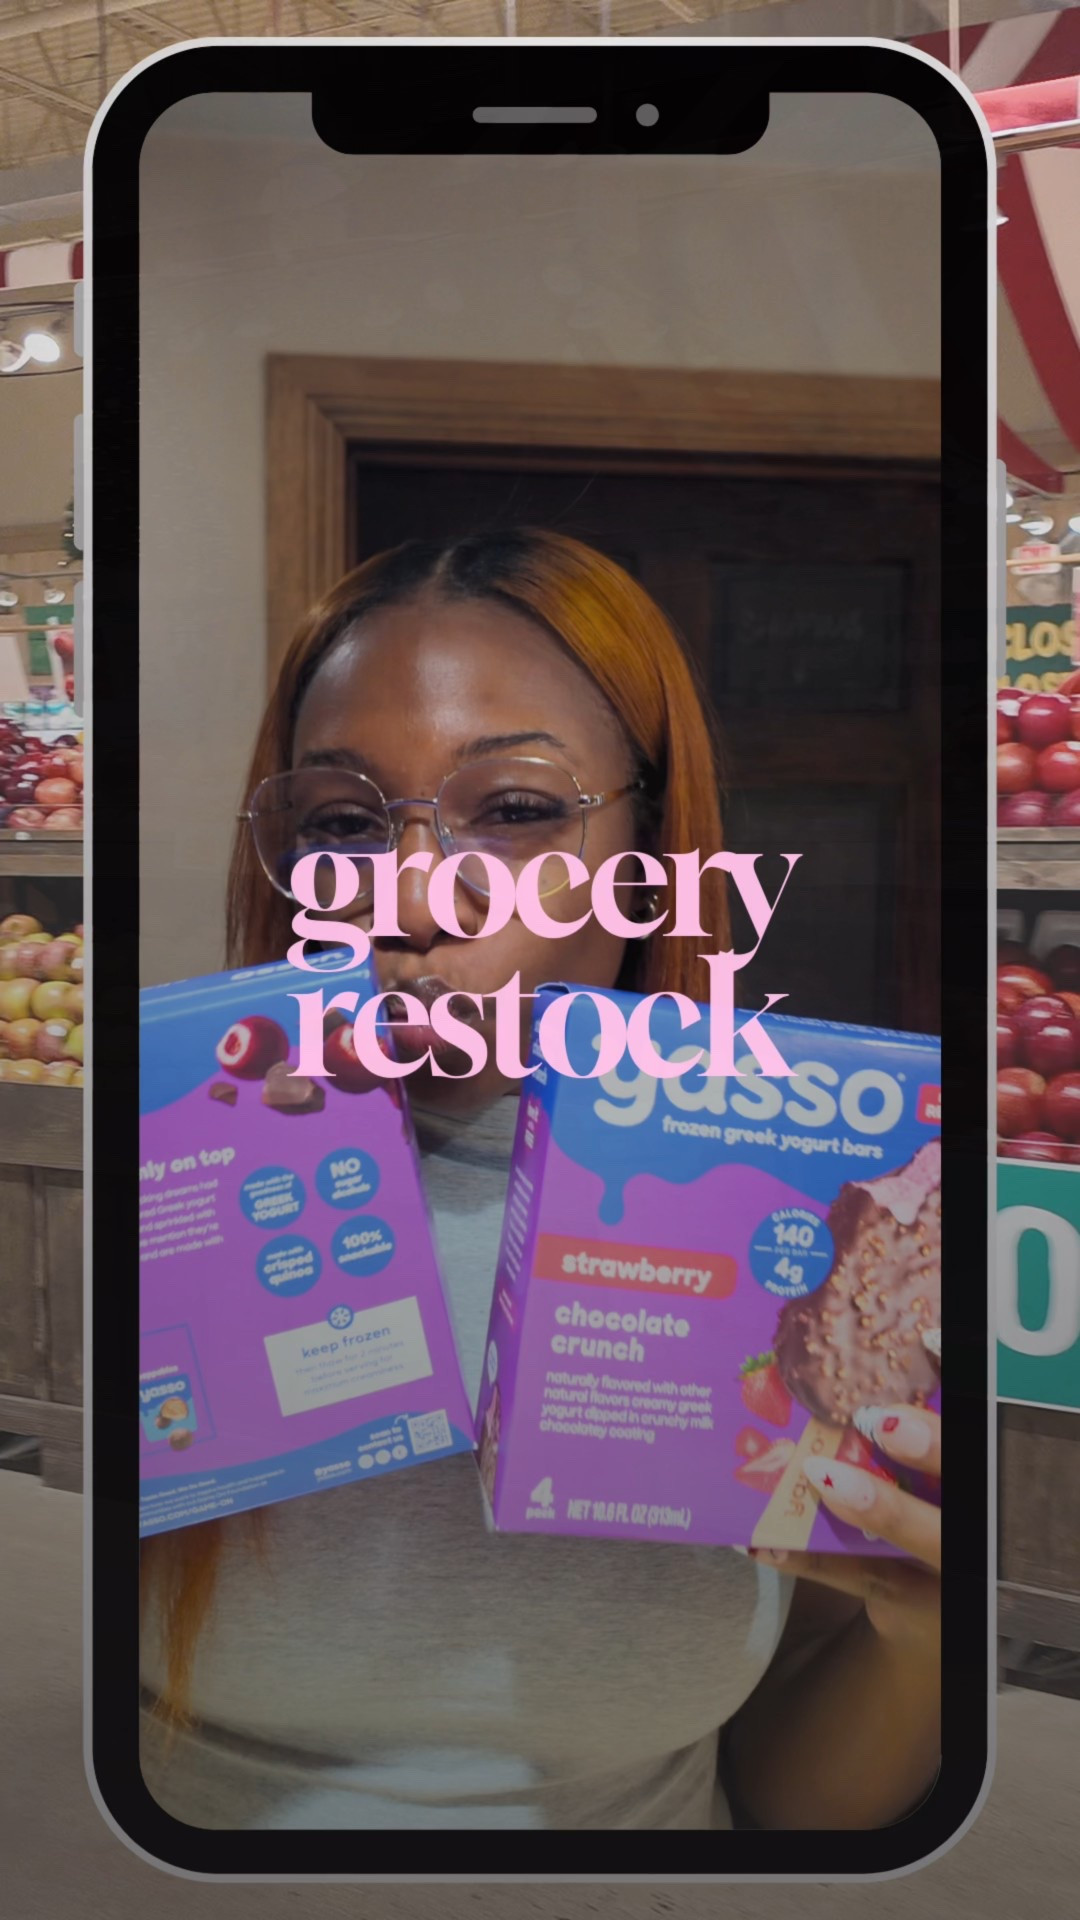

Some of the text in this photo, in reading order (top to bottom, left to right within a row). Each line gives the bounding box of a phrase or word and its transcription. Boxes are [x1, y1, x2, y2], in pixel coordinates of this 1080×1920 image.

[662, 1115, 884, 1160] frozen greek yogurt bars
[170, 1156, 197, 1173] on
[199, 1146, 236, 1167] top
[330, 1157, 361, 1180] NO
[342, 1228, 383, 1250] 100%
[773, 1222, 814, 1248] 140
[561, 1251, 712, 1294] strawberry
[773, 1256, 804, 1285] 4g
[555, 1300, 690, 1338] chocolate
[302, 1326, 391, 1359] keep frozen
[551, 1334, 645, 1363] crunch
[546, 1370, 712, 1399] naturally flavored with other
[544, 1386, 712, 1415] natural flavors creamy greek
[541, 1403, 582, 1420] yogurt
[584, 1405, 627, 1424] dipped
[641, 1412, 689, 1432] crunchy
[609, 1426, 656, 1445] coating
[530, 1476, 554, 1508] 4
[567, 1498, 591, 1520] NET
